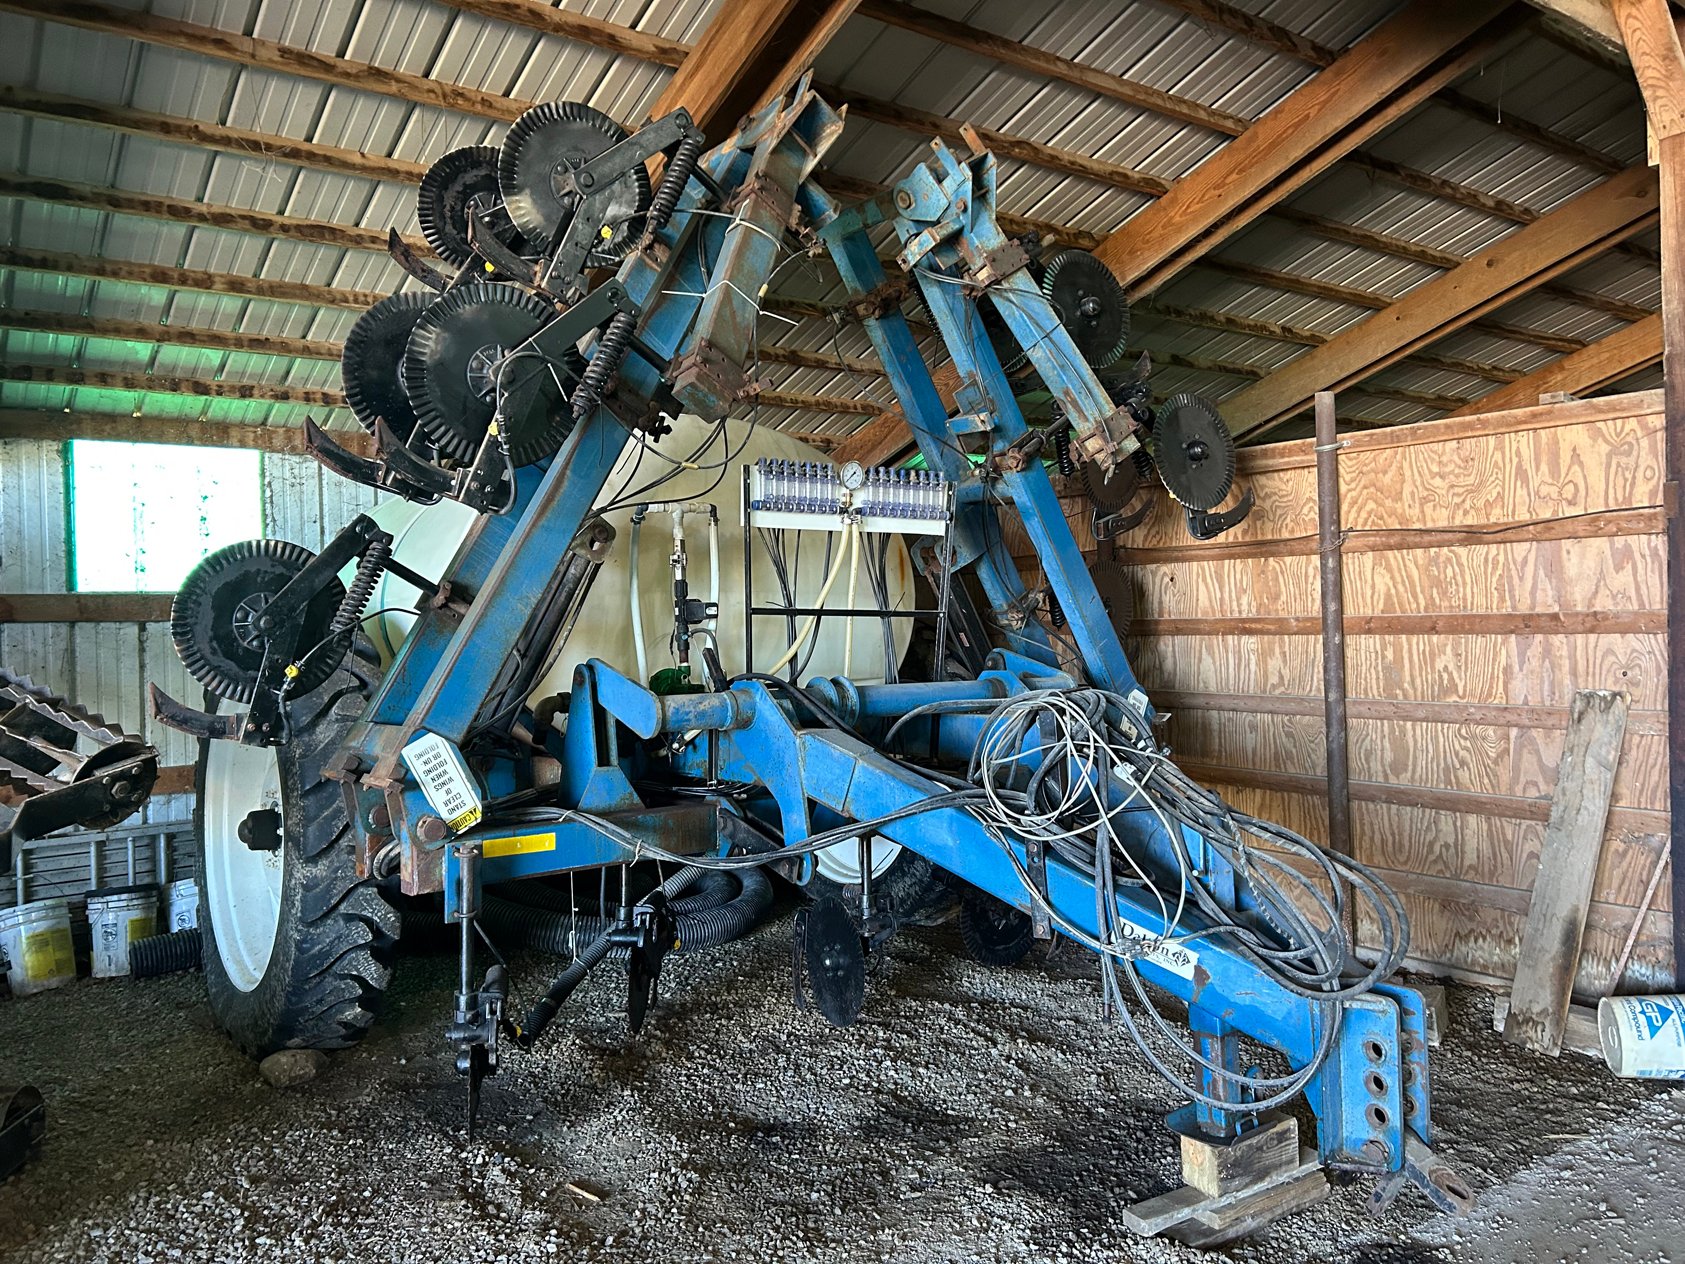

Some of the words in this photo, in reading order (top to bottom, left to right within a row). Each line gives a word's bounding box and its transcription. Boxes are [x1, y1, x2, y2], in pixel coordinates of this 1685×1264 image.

[414, 742, 439, 761] FOLDING
[432, 751, 442, 761] OR
[423, 758, 448, 777] FOLDING
[431, 769, 448, 783] WHEN
[434, 776, 454, 792] WINGS
[443, 792, 462, 808] CLEAR
[445, 788, 452, 796] OF
[447, 800, 466, 816] STAND
[1642, 1001, 1662, 1027] GP
[1629, 1004, 1645, 1041] Compound
